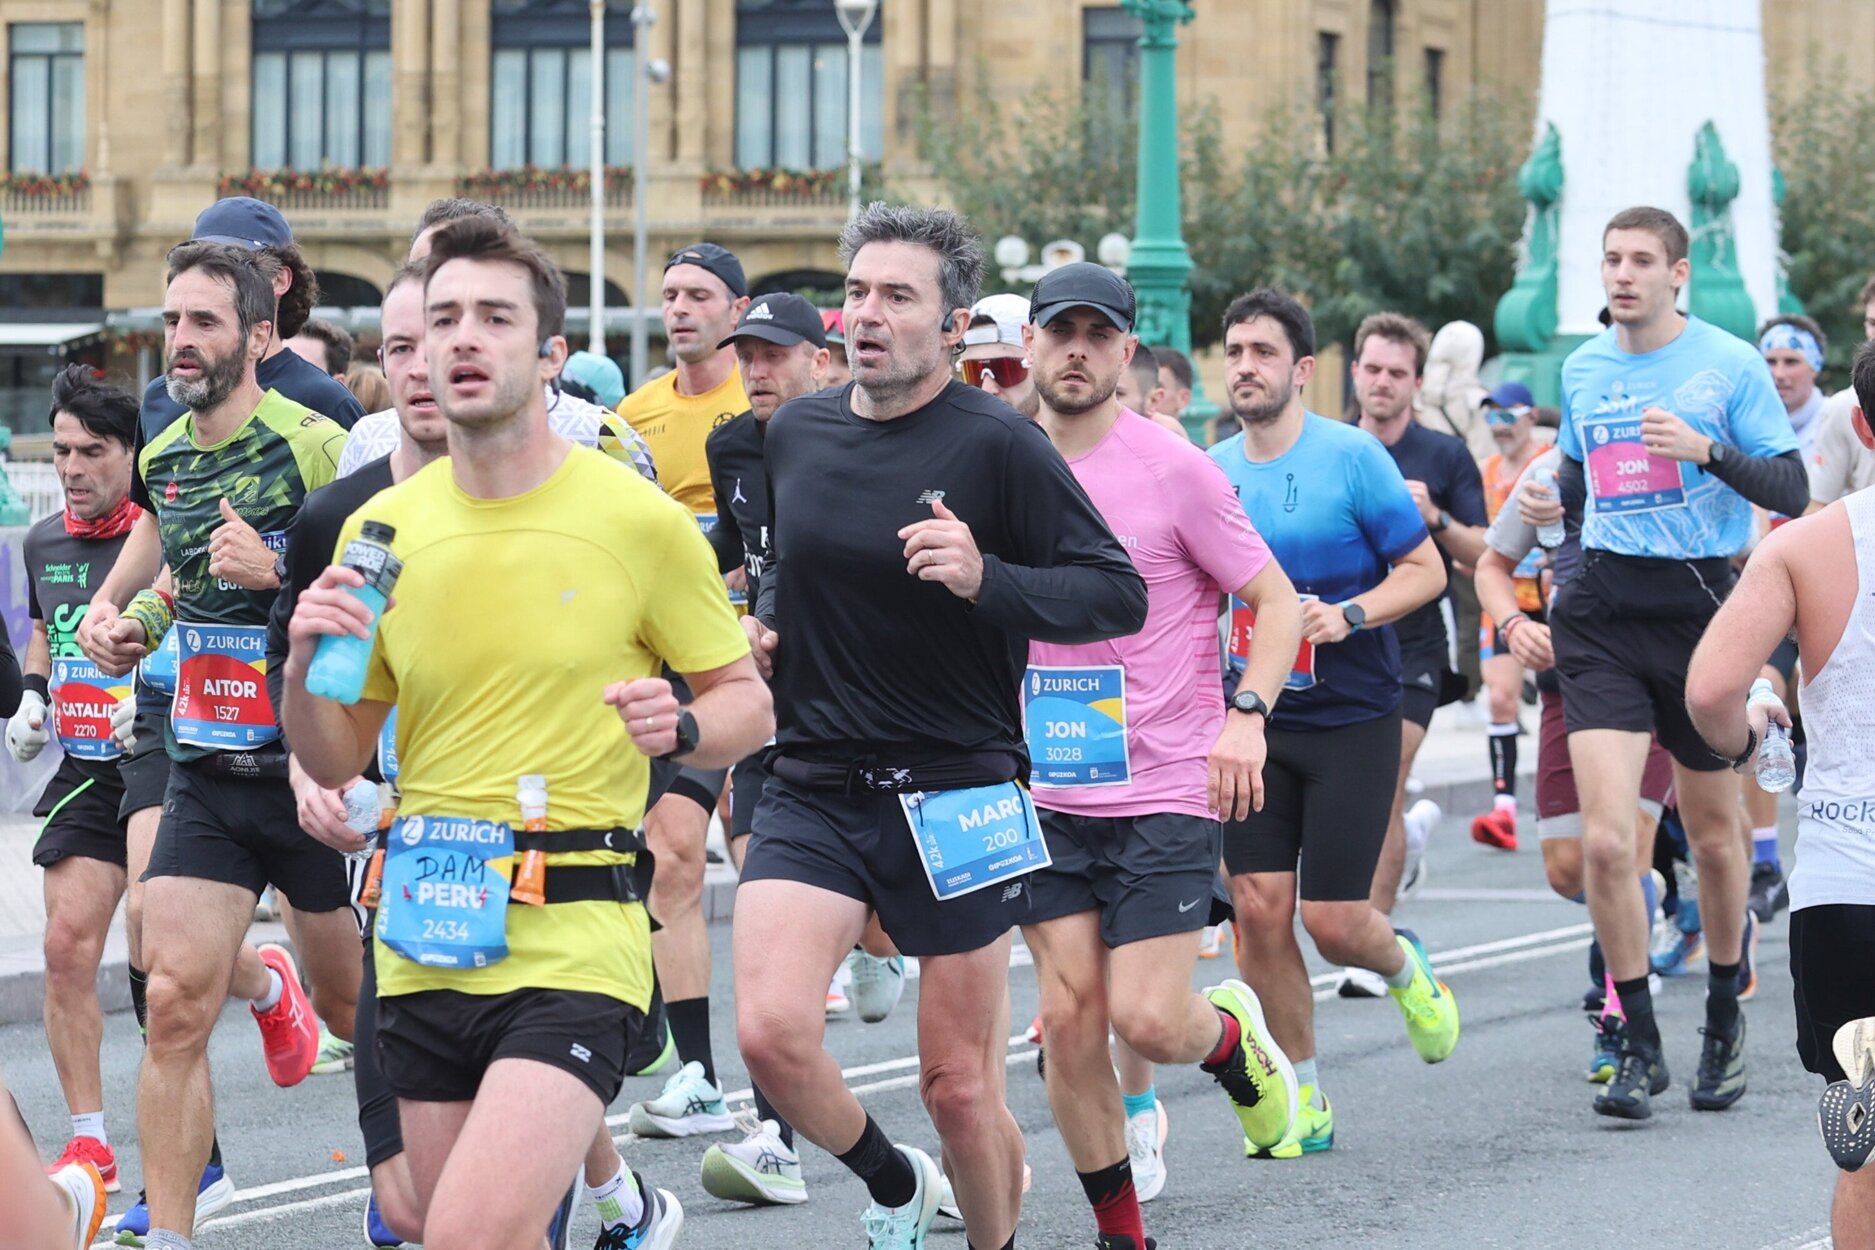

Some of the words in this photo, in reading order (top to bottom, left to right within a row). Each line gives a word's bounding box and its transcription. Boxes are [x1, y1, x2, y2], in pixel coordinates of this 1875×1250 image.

[1612, 427, 1641, 440] ZURI
[1616, 458, 1650, 475] JON
[54, 574, 74, 583] PARIS
[206, 635, 261, 650] ZURICH
[203, 678, 258, 699] AITOR
[1043, 677, 1100, 692] ZURICH
[214, 705, 240, 721] 1527
[74, 724, 97, 737] 2270
[1044, 721, 1087, 738] JON
[1045, 747, 1082, 761] 3028
[428, 821, 506, 844] ZURICH
[982, 827, 1019, 852] 200
[415, 854, 486, 883] DAM
[422, 919, 470, 941] 2434
[1246, 1029, 1277, 1077] HOKA
